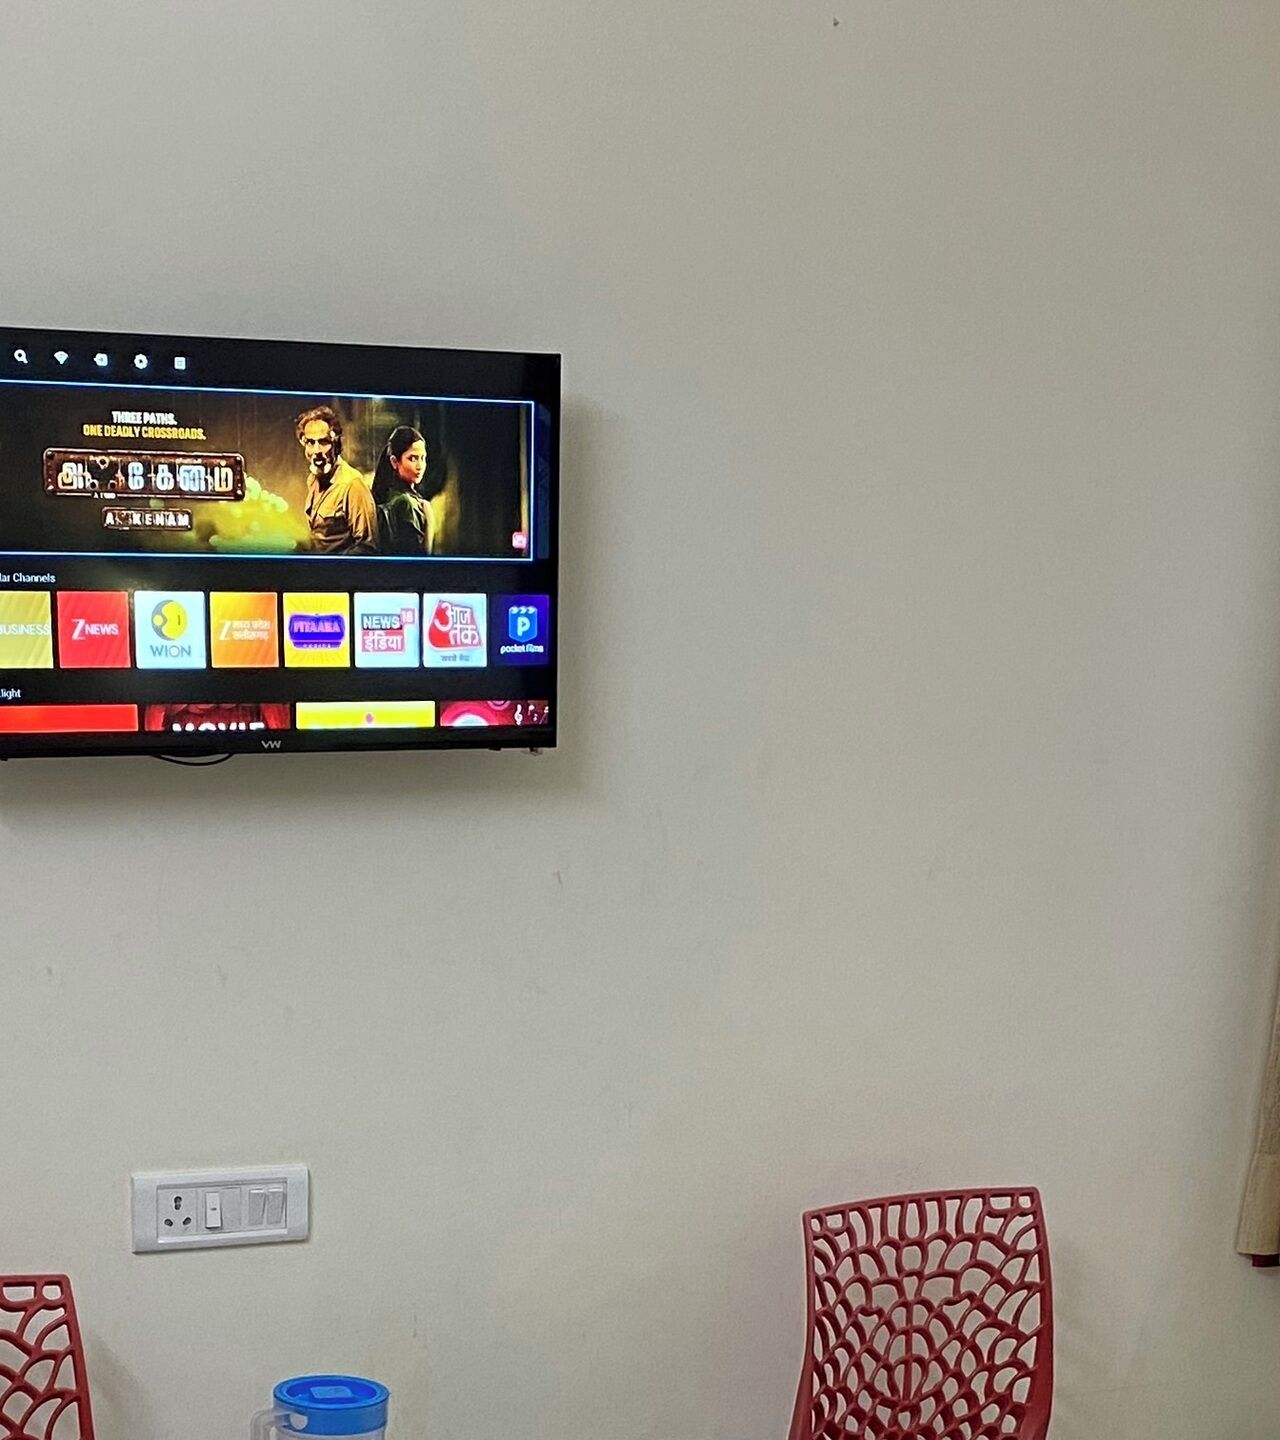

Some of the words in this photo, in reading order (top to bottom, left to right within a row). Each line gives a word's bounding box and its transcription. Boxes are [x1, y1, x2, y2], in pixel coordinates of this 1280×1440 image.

[111, 411, 142, 424] THREE
[143, 412, 177, 425] PATHS.
[83, 424, 103, 436] ONE
[104, 425, 140, 438] DEADLY
[12, 572, 56, 583] Channels
[362, 615, 400, 630] NEWS
[401, 610, 414, 624] 18
[433, 602, 472, 631] आज
[85, 623, 119, 636] NEWS
[449, 625, 479, 645] तक
[363, 631, 403, 652] इंडिया
[150, 645, 191, 658] WION
